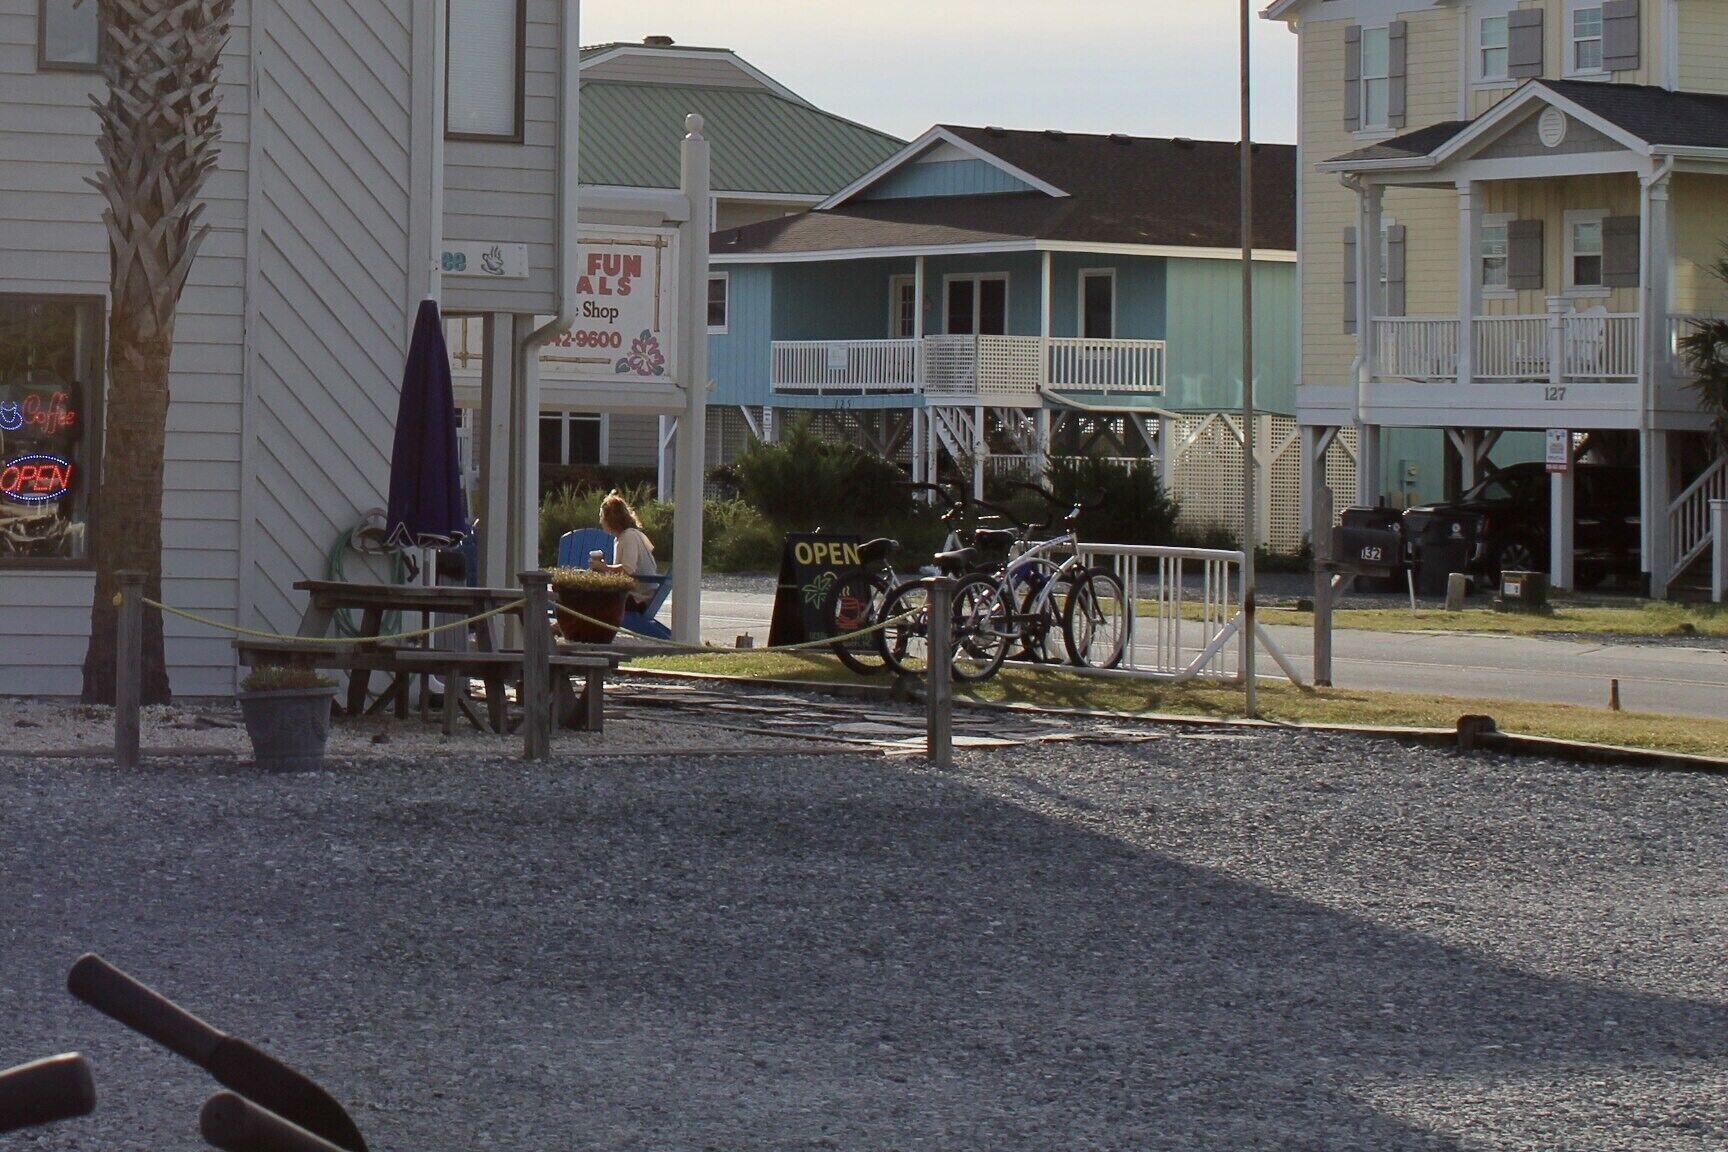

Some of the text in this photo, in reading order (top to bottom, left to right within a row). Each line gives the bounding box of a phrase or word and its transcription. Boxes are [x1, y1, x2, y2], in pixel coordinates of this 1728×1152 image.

[587, 252, 642, 278] FUN
[575, 275, 633, 296] ALS
[582, 300, 619, 324] Shop
[1545, 386, 1567, 401] 127
[22, 391, 76, 436] Coffee
[0, 464, 72, 492] OPEN
[794, 541, 862, 566] OPEN
[1361, 547, 1382, 560] 132
